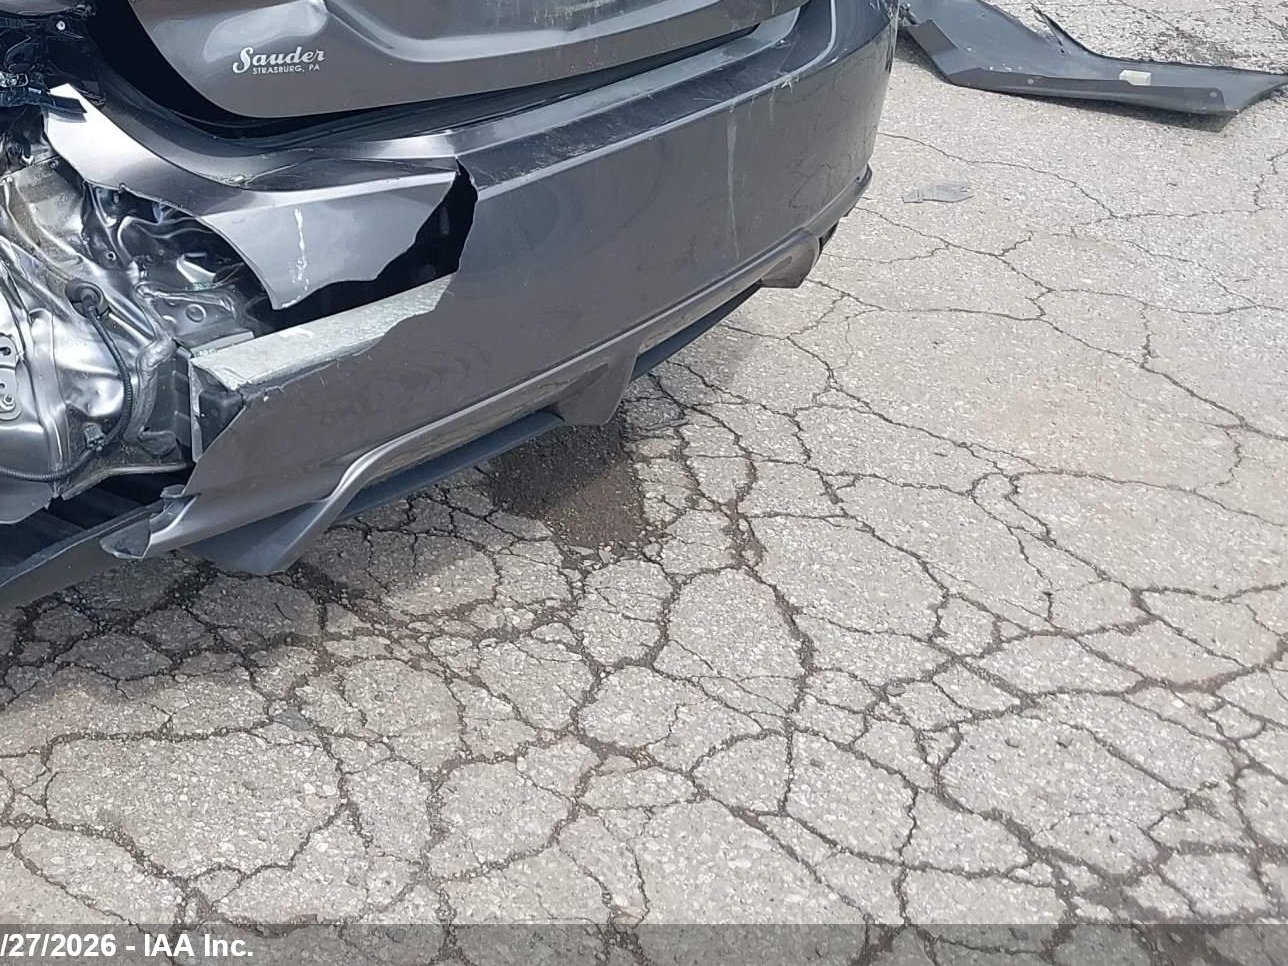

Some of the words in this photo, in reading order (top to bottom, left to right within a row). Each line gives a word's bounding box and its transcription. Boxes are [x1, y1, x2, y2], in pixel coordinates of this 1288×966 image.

[232, 46, 325, 73] Sauder
[252, 64, 305, 74] STRASBURG,
[309, 63, 320, 71] PA
